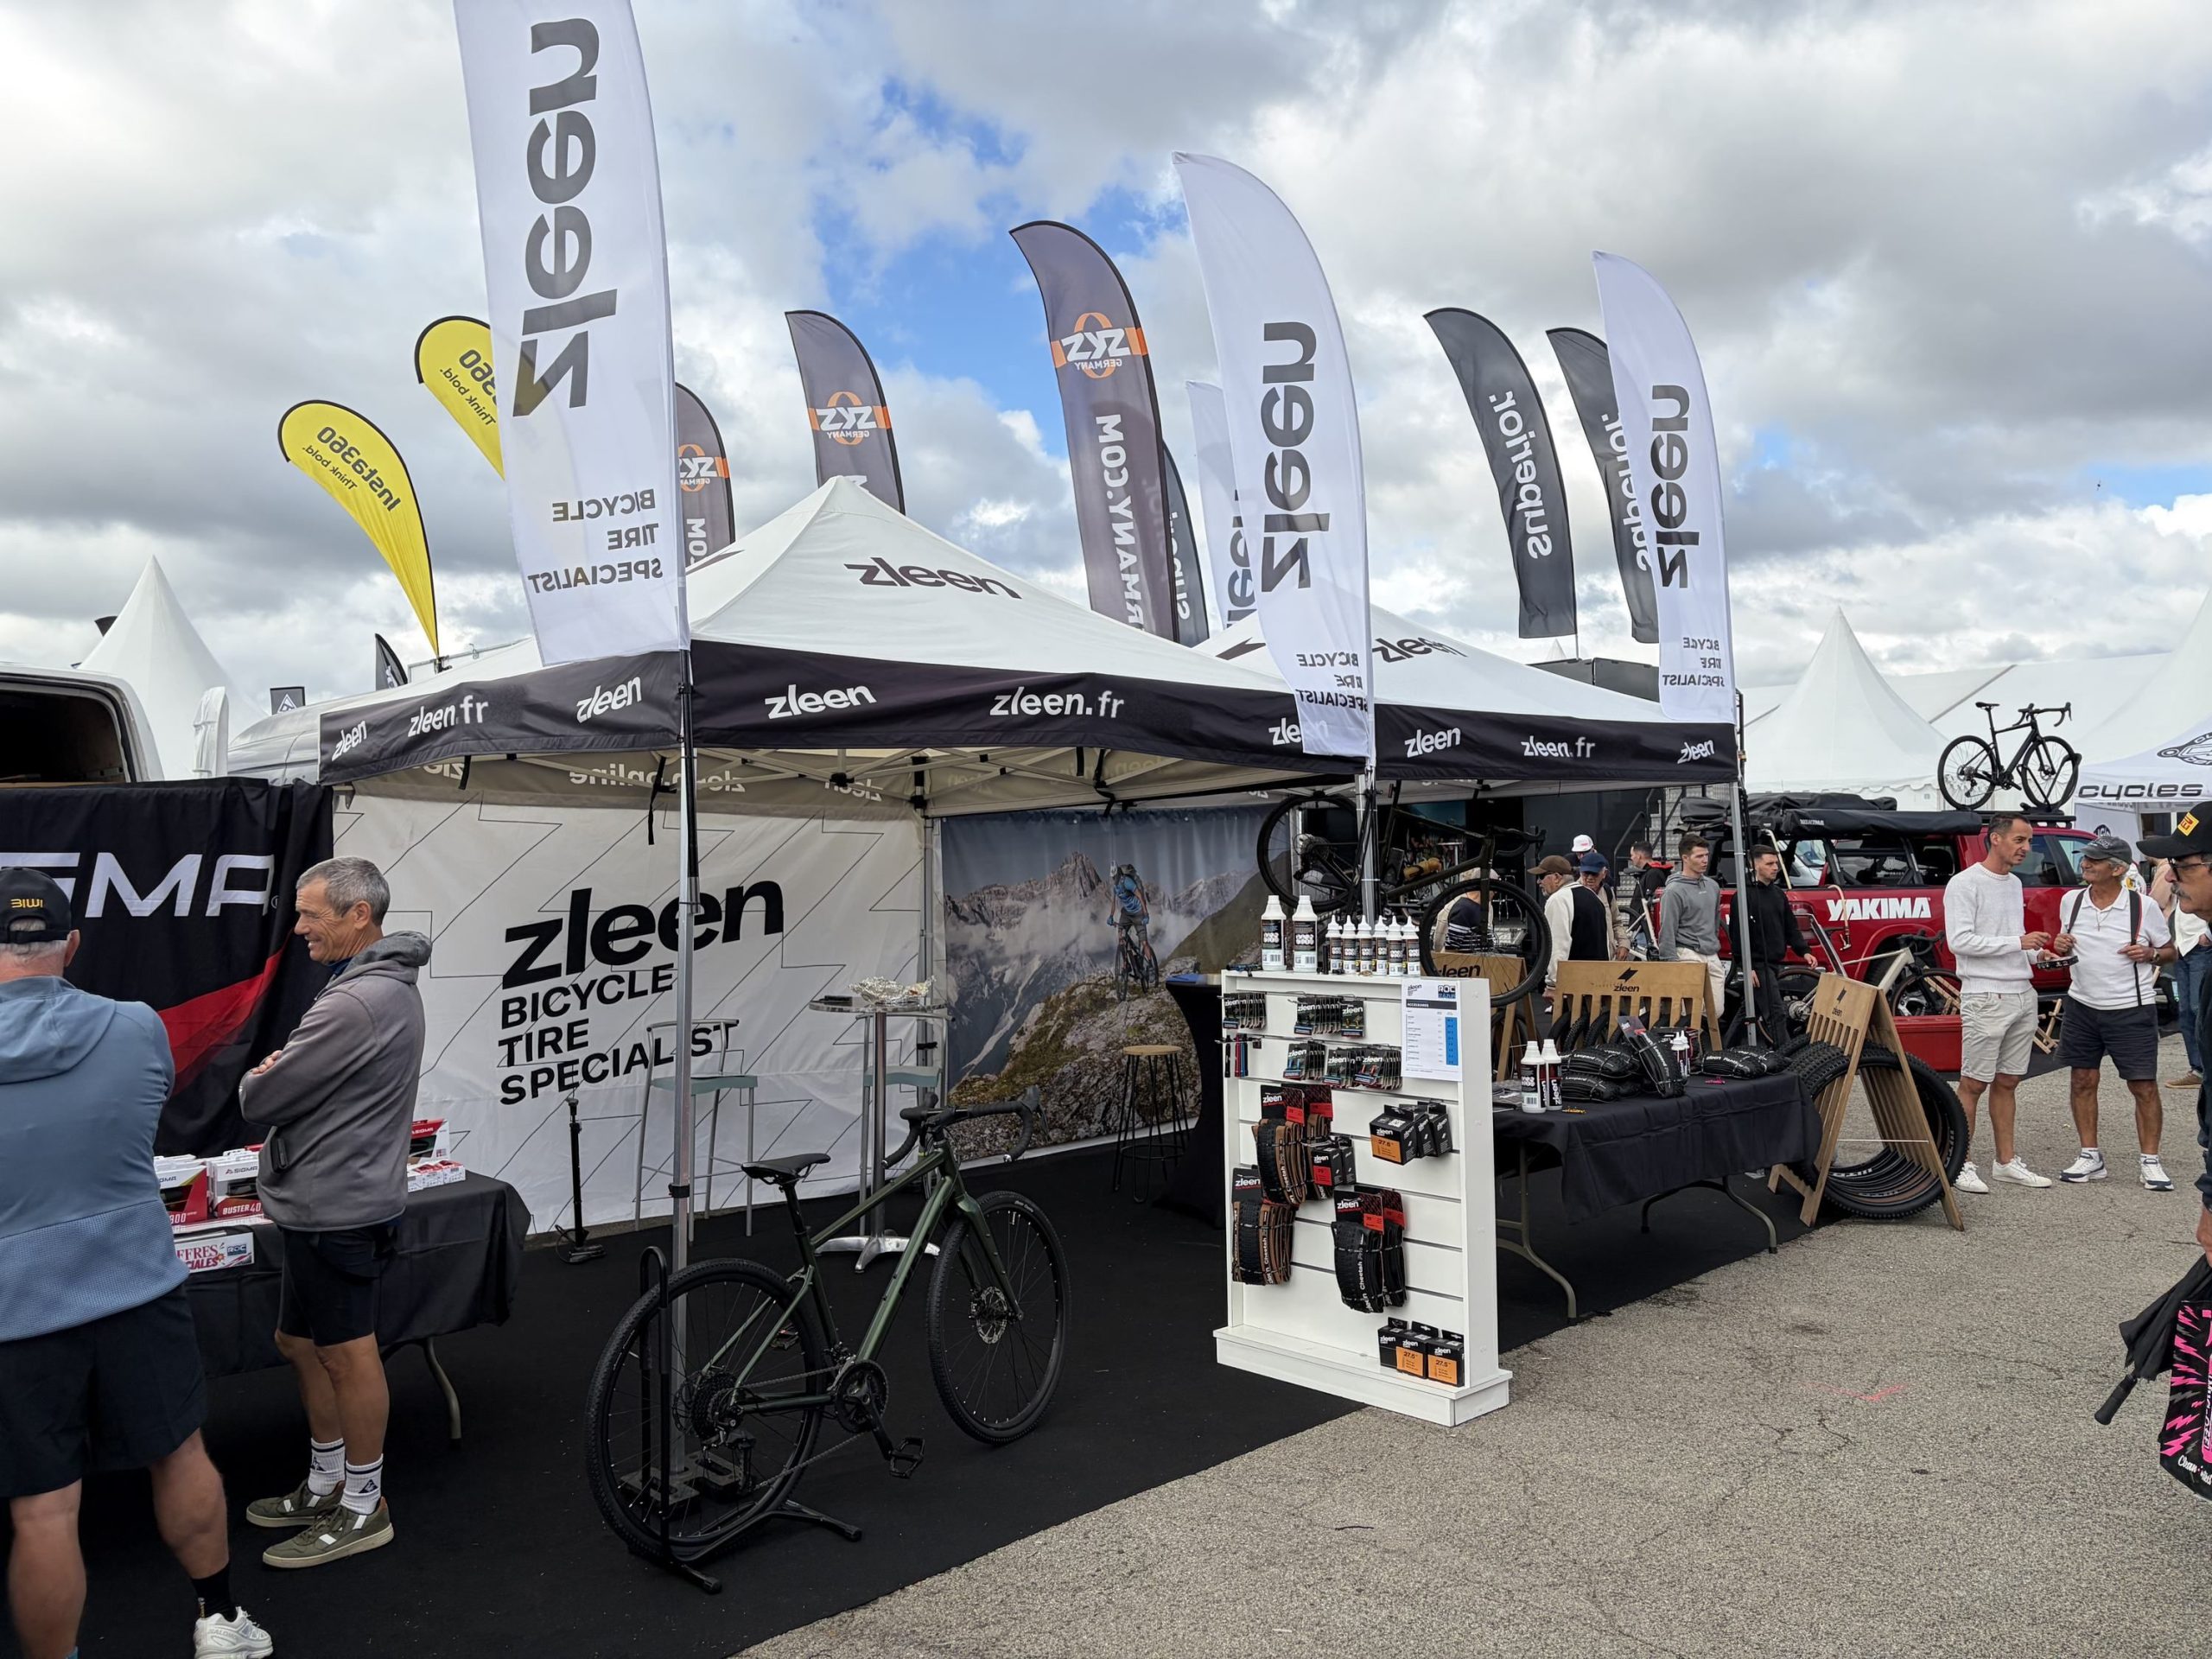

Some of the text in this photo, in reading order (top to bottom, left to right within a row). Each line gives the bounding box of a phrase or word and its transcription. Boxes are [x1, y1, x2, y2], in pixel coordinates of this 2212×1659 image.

[843, 556, 1022, 600] zleen
[406, 694, 489, 738] zleen.fr
[575, 676, 642, 724] zleen
[764, 683, 877, 720] zleen
[989, 686, 1125, 720] zleen.fr
[331, 720, 367, 762] zleen
[1404, 727, 1461, 759] zleen
[1521, 734, 1596, 760] zleen.fr
[1676, 738, 1714, 765] zleen
[2077, 782, 2204, 801] cycles
[1826, 896, 1932, 922] YAKIMA
[502, 880, 784, 990] zleen
[1438, 964, 1481, 978] leen
[501, 963, 675, 1030] BICYCLE
[1613, 983, 1640, 993] zleen
[498, 1018, 589, 1068] TIRE
[499, 1023, 738, 1106] SPECIALST
[1262, 1095, 1283, 1103] zleen
[1235, 1178, 1261, 1187] zleen
[1337, 1199, 1359, 1210] zleen
[176, 1244, 219, 1262] FFRES
